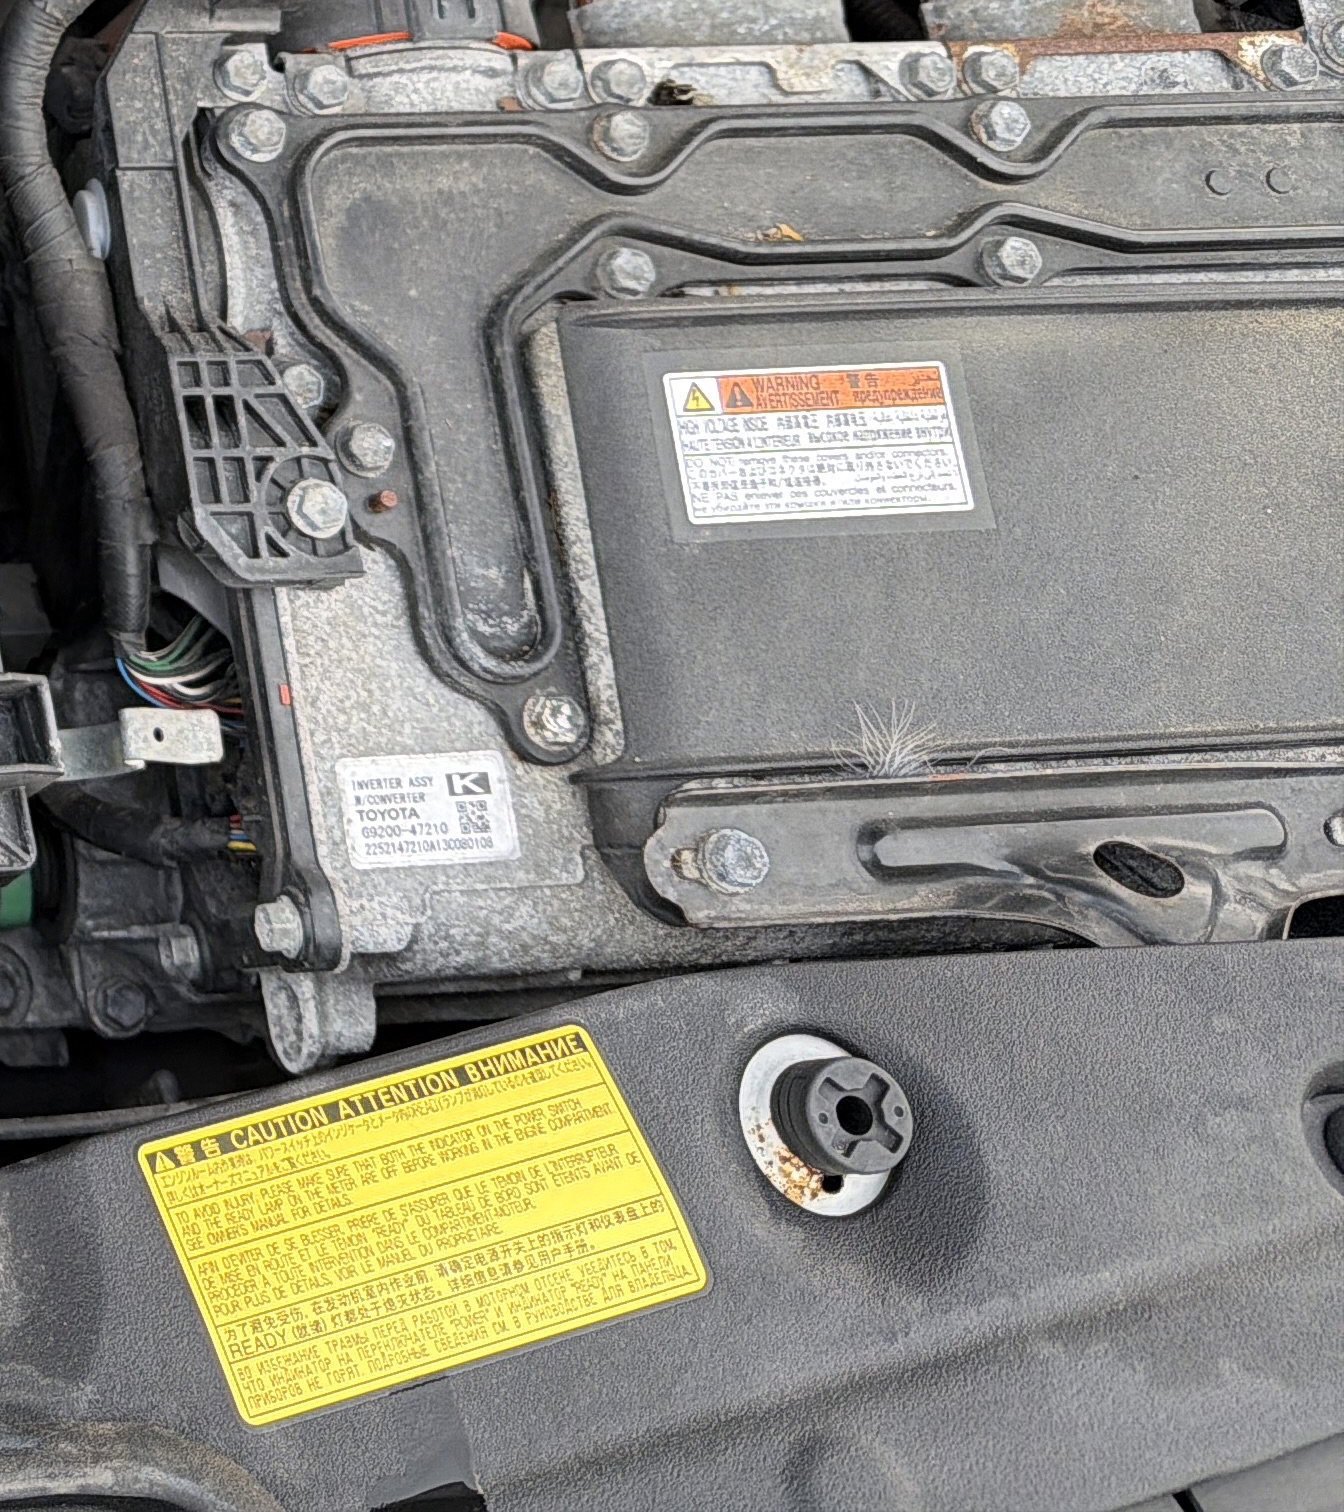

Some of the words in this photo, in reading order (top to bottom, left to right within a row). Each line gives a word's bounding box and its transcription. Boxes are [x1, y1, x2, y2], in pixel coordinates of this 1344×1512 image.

[752, 374, 821, 392] WARNING
[755, 389, 840, 409] AVERTISSEMENT
[352, 777, 403, 791] INVERTER
[408, 776, 433, 788] ASSY
[357, 807, 421, 822] TOYOTA
[463, 1033, 584, 1082] ВНИМАНИЕ
[227, 1105, 329, 1150] CAUTION
[333, 1068, 460, 1120] ATTENTION
[227, 1327, 290, 1359] READY
